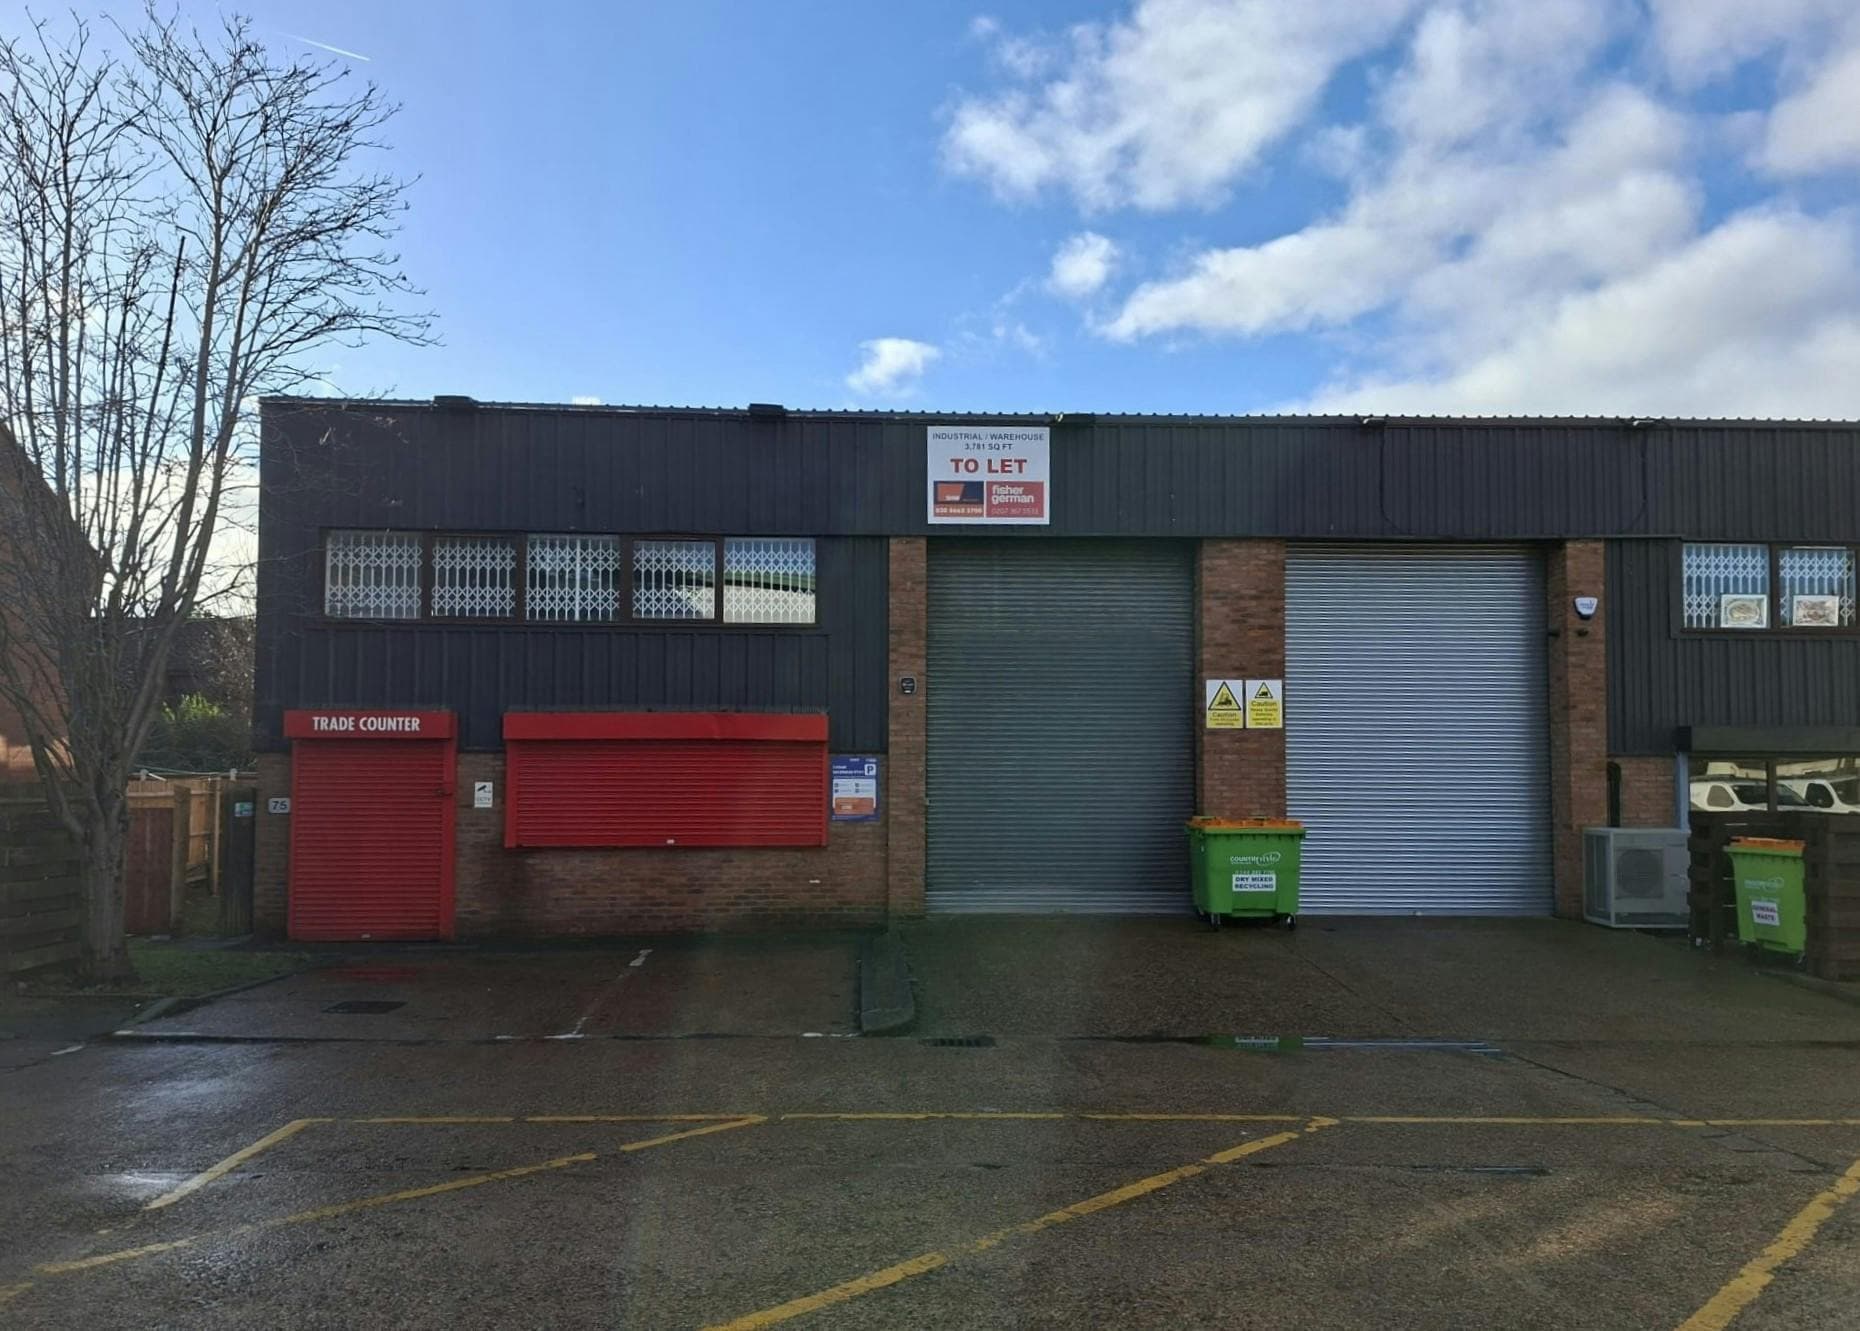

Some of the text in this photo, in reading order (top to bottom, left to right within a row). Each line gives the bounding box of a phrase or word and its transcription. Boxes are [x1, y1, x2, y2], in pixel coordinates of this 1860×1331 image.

[932, 432, 983, 440] INDUSTRIAL
[989, 432, 1045, 441] WAREHOUSE
[964, 443, 986, 451] 3,781
[988, 443, 1000, 451] SQ
[950, 458, 1027, 473] TO LET
[992, 485, 1024, 494] fisher
[992, 494, 1035, 505] german
[312, 716, 420, 732] TRADE COUNTER
[272, 800, 288, 810] 75
